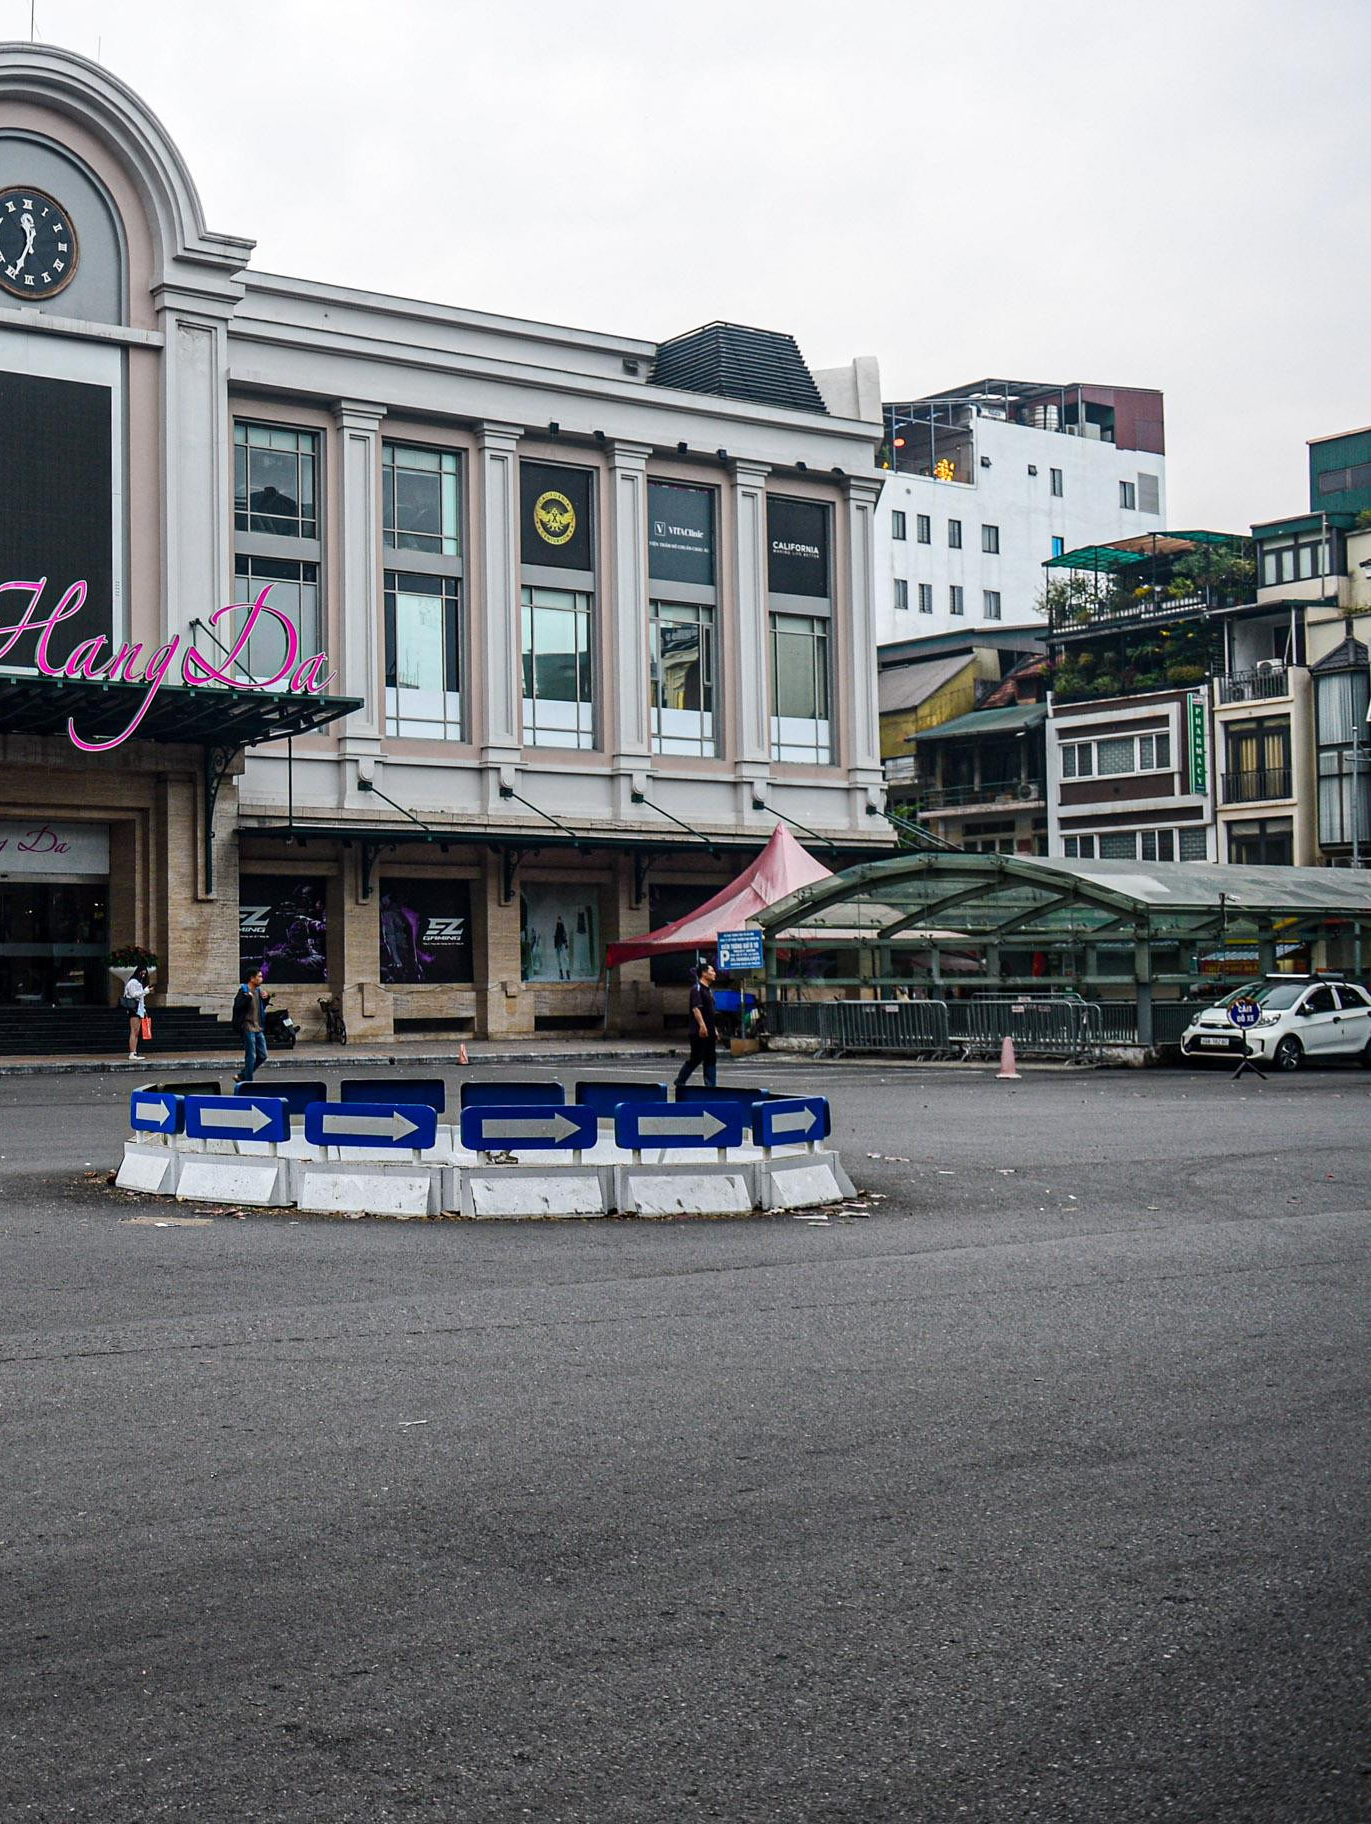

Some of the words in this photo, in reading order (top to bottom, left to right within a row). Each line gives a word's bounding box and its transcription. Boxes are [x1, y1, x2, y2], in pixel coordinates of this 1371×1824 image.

[772, 541, 819, 553] CALIFORNIA
[182, 582, 337, 694] Da
[1195, 707, 1204, 785] PHARMACY
[18, 824, 71, 854] Da
[720, 950, 729, 967] P
